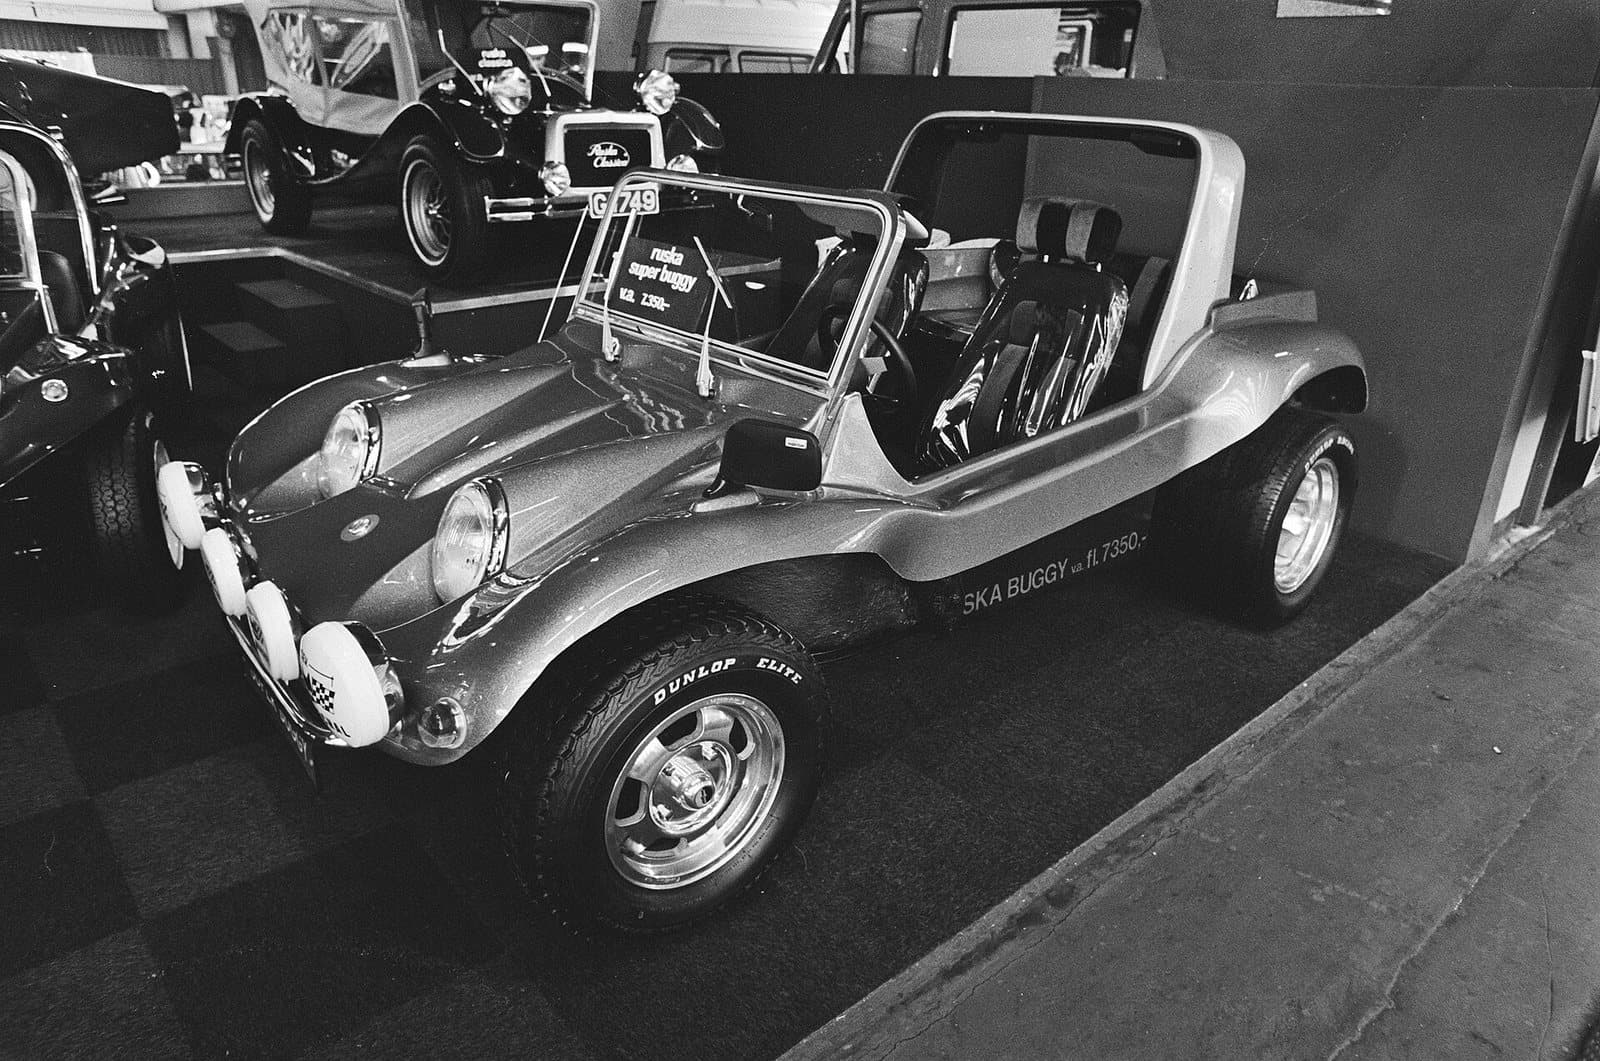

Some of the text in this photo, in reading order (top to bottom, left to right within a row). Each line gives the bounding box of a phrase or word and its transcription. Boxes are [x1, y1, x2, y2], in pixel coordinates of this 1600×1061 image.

[650, 246, 684, 266] ruska
[628, 262, 698, 293] super buggy
[1007, 558, 1069, 599] BUGGY
[1102, 531, 1148, 563] 7350,-
[654, 657, 803, 706] DUNLOP ELITE
